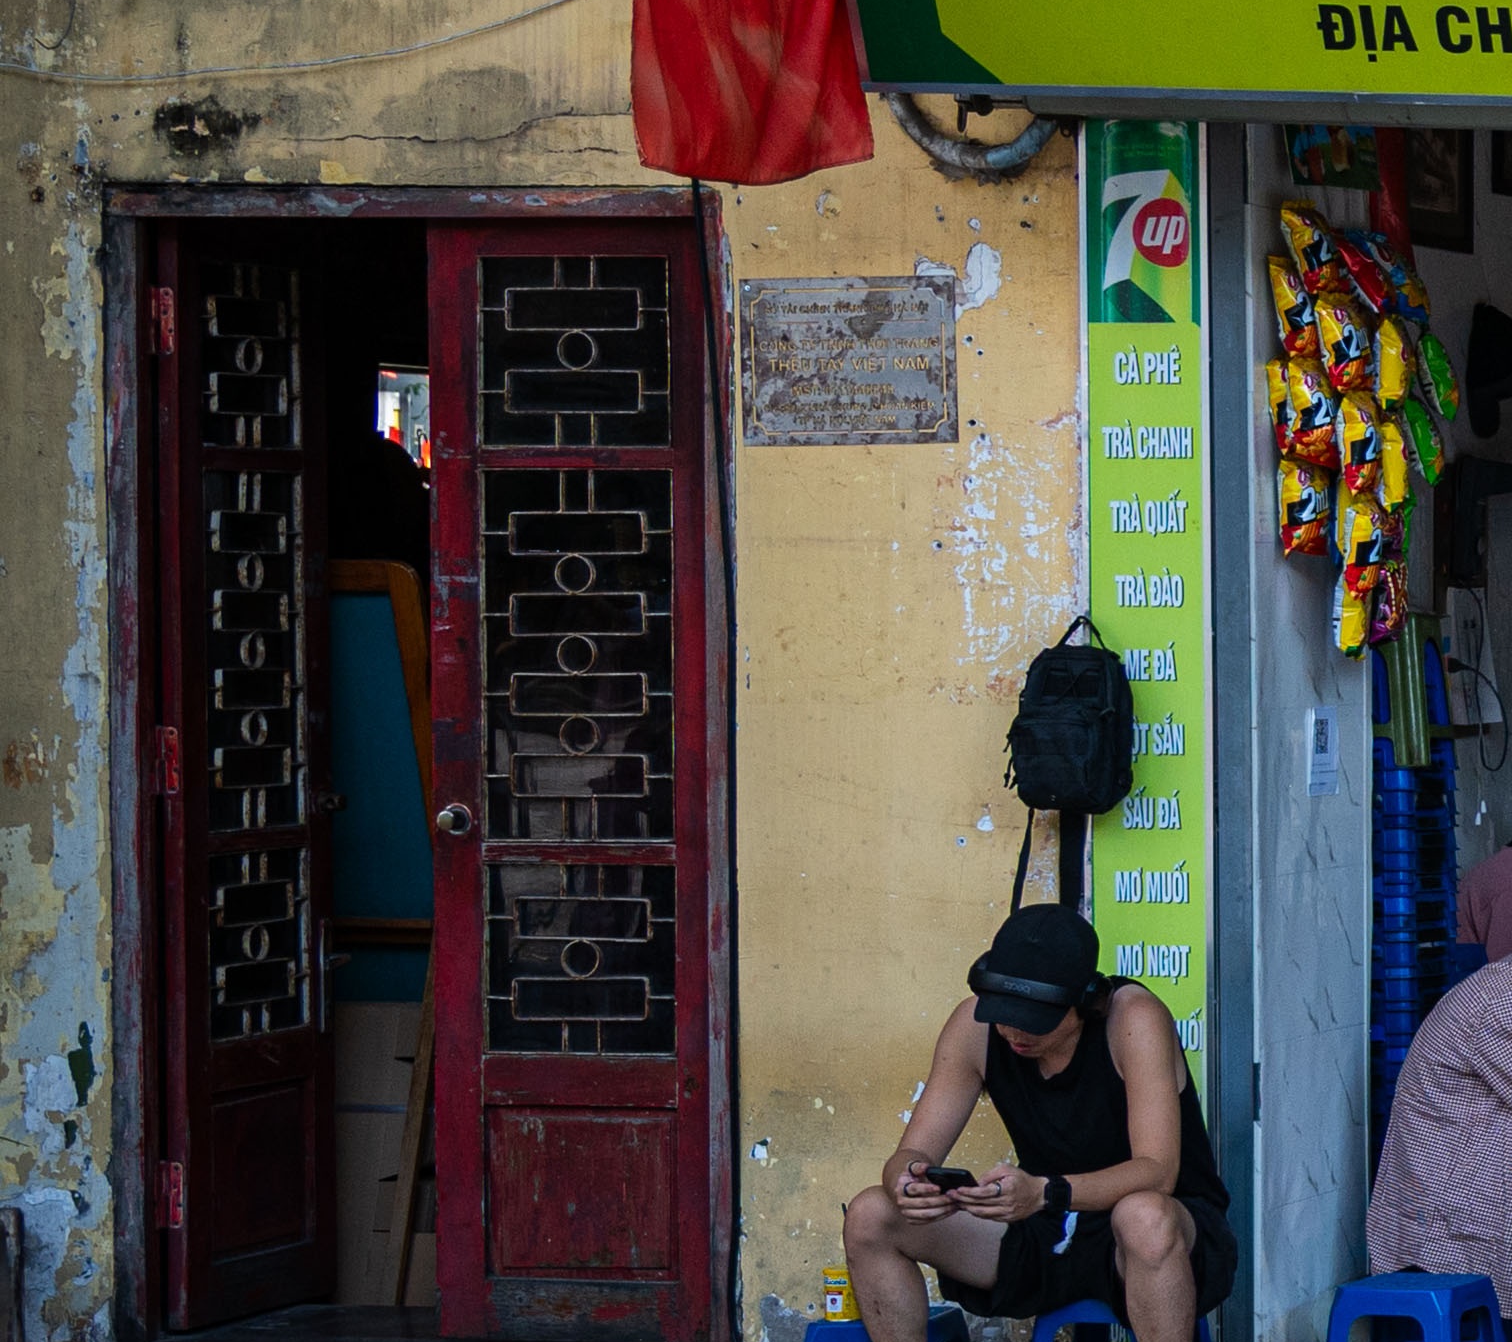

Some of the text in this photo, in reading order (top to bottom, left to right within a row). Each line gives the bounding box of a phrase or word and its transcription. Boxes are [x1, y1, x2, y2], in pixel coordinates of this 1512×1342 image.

[1317, 3, 1418, 64] ĐỊA
[893, 356, 930, 371] NAM
[1114, 343, 1182, 386] CÀ PHÊ
[1102, 418, 1193, 461] TRÀ CHANH
[1110, 490, 1188, 539] TRÀ QUẤT
[1115, 566, 1184, 608] TRÀ ĐÀO
[1124, 640, 1178, 682] ME ĐÁ
[1152, 712, 1186, 757] SẮN
[1122, 786, 1182, 830] SẤU ĐÁ
[1114, 861, 1190, 904] MƠ MUỐI
[1117, 941, 1191, 984] MƠ NGỌT
